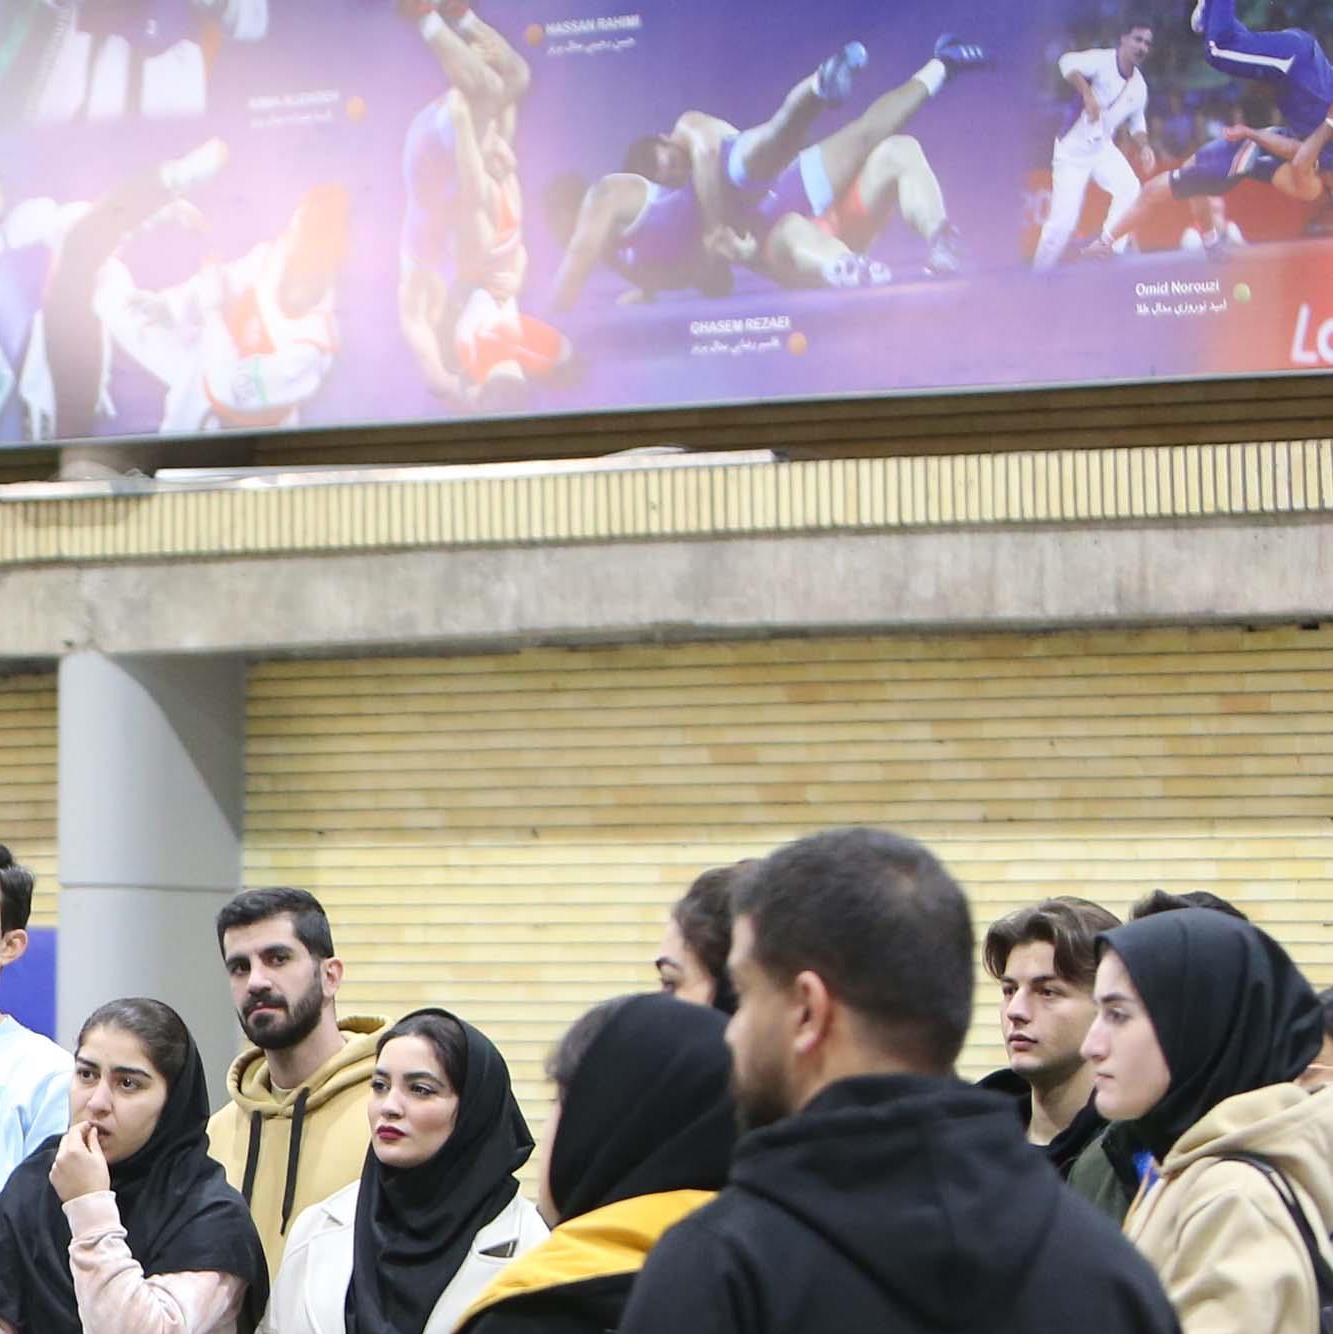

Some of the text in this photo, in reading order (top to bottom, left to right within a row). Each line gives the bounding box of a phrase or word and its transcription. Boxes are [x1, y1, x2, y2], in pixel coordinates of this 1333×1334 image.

[1135, 279, 1220, 297] Omid Norouzi
[745, 315, 791, 332] REZAEI
